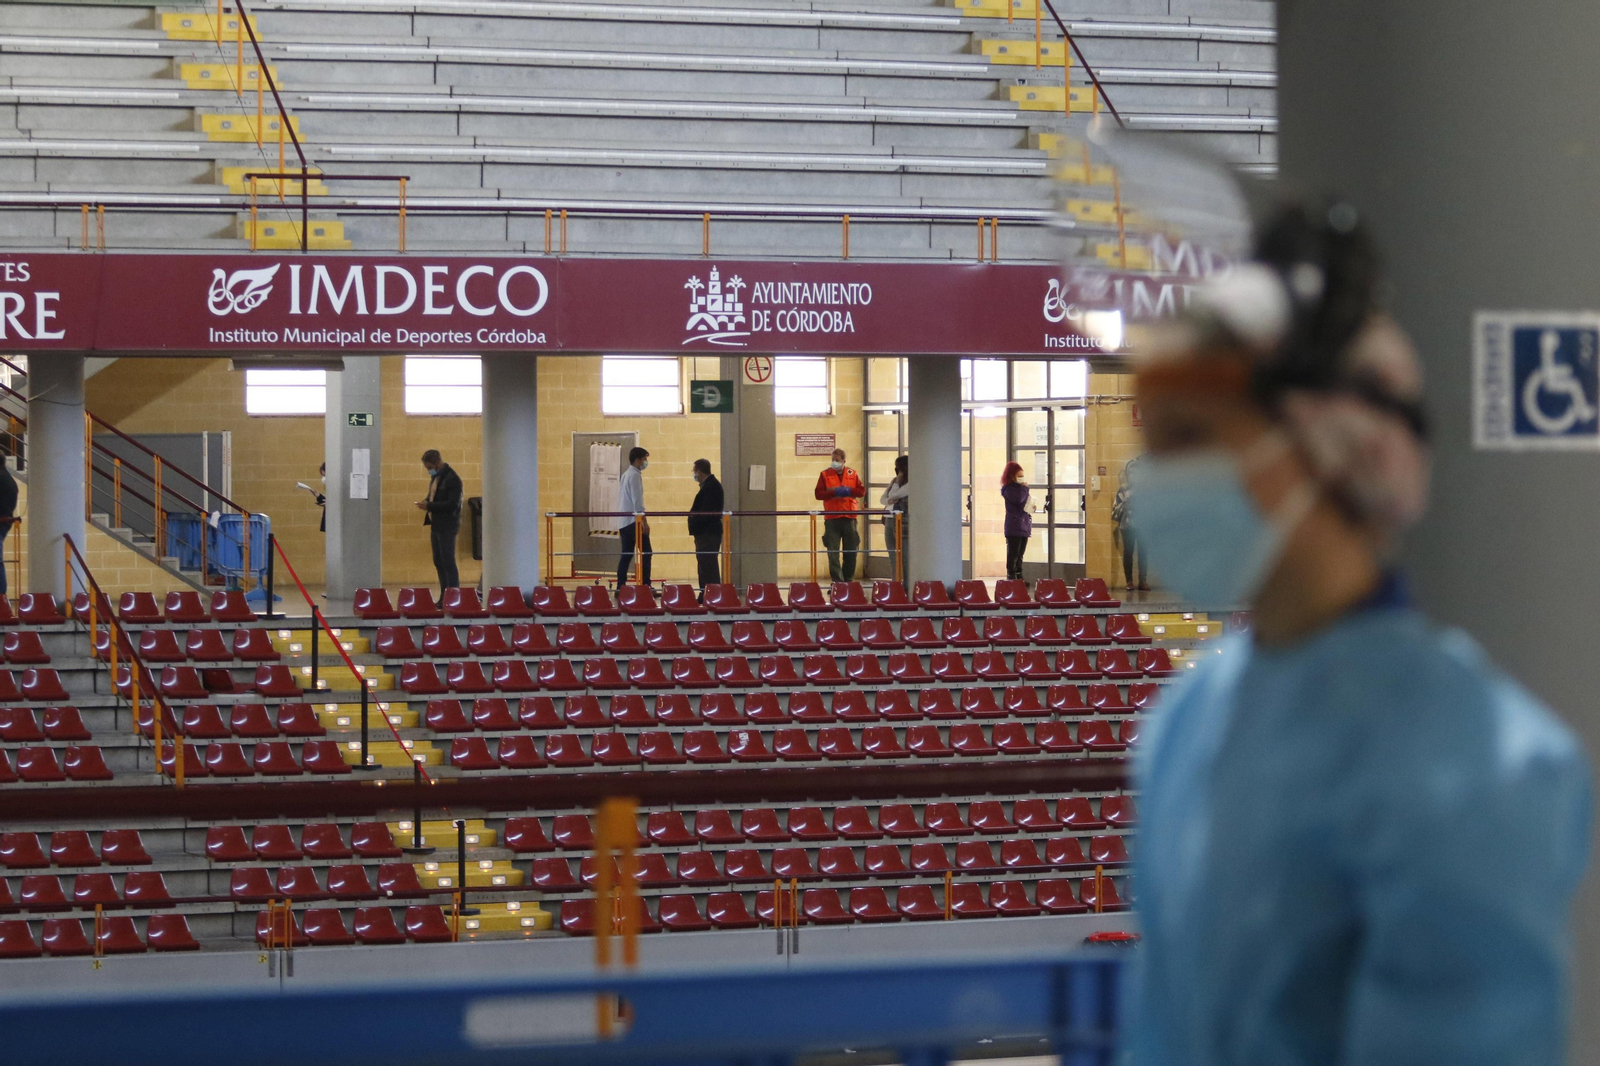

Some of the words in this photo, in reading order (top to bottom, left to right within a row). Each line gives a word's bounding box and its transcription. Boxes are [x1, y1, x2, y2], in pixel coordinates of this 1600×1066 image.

[288, 264, 549, 317] IMDECO
[751, 282, 873, 306] AYUNTAMIENTO
[751, 309, 773, 333] DE
[776, 306, 856, 333] CÓRDOBA
[208, 327, 279, 343] Instituto
[283, 327, 366, 347] Municipal
[370, 328, 392, 343] de
[396, 328, 473, 347] Deportes
[476, 328, 547, 344] Córdoba
[1044, 333, 1104, 348] Instituto
